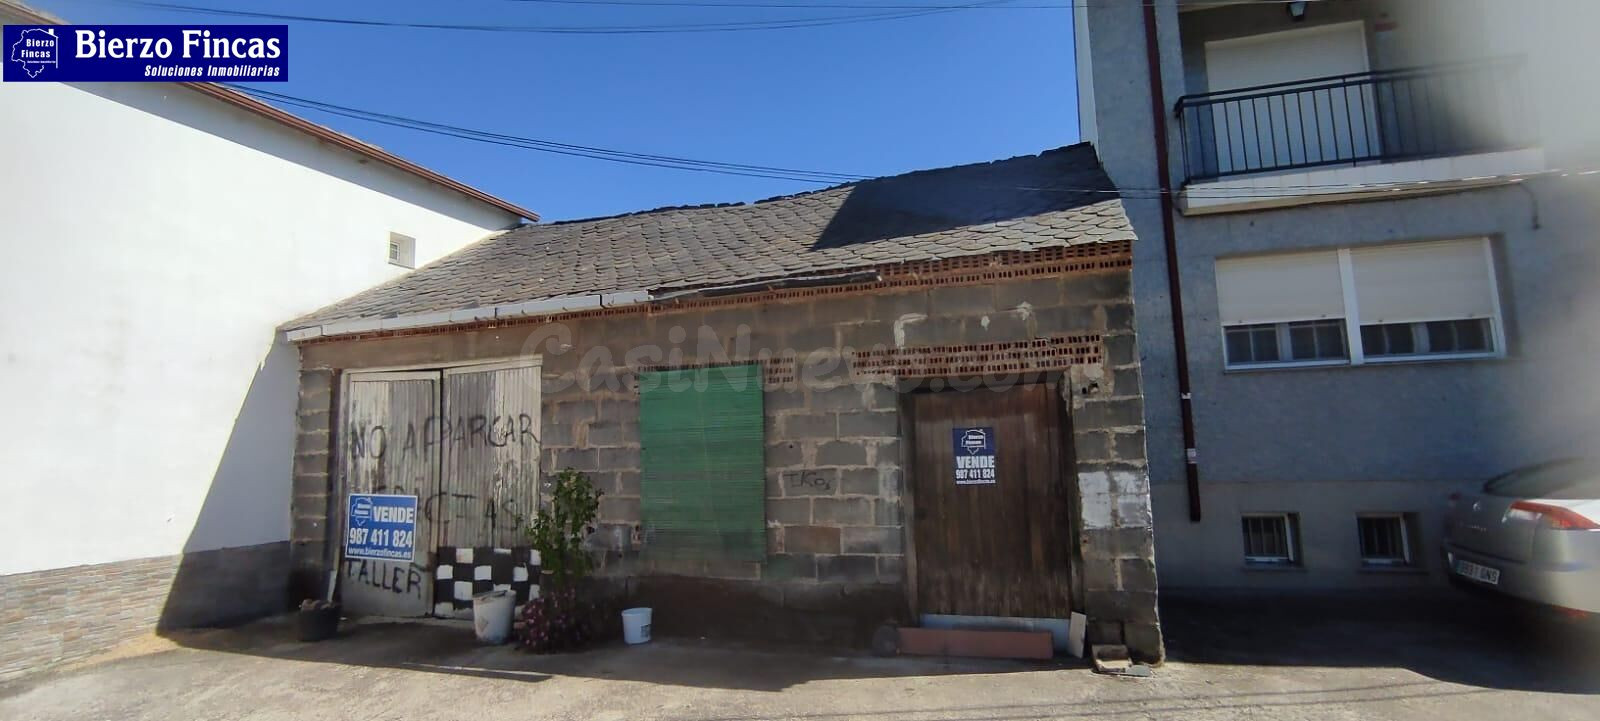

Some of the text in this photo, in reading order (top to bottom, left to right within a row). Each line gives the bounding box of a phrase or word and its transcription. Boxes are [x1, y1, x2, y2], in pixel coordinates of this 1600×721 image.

[351, 413, 540, 460] NO APARCAR
[956, 455, 995, 469] VENDE
[955, 468, 995, 479] 987 411 824
[373, 506, 414, 524] VENDE
[349, 527, 412, 548] 987 411 824
[345, 558, 421, 600] TALLER
